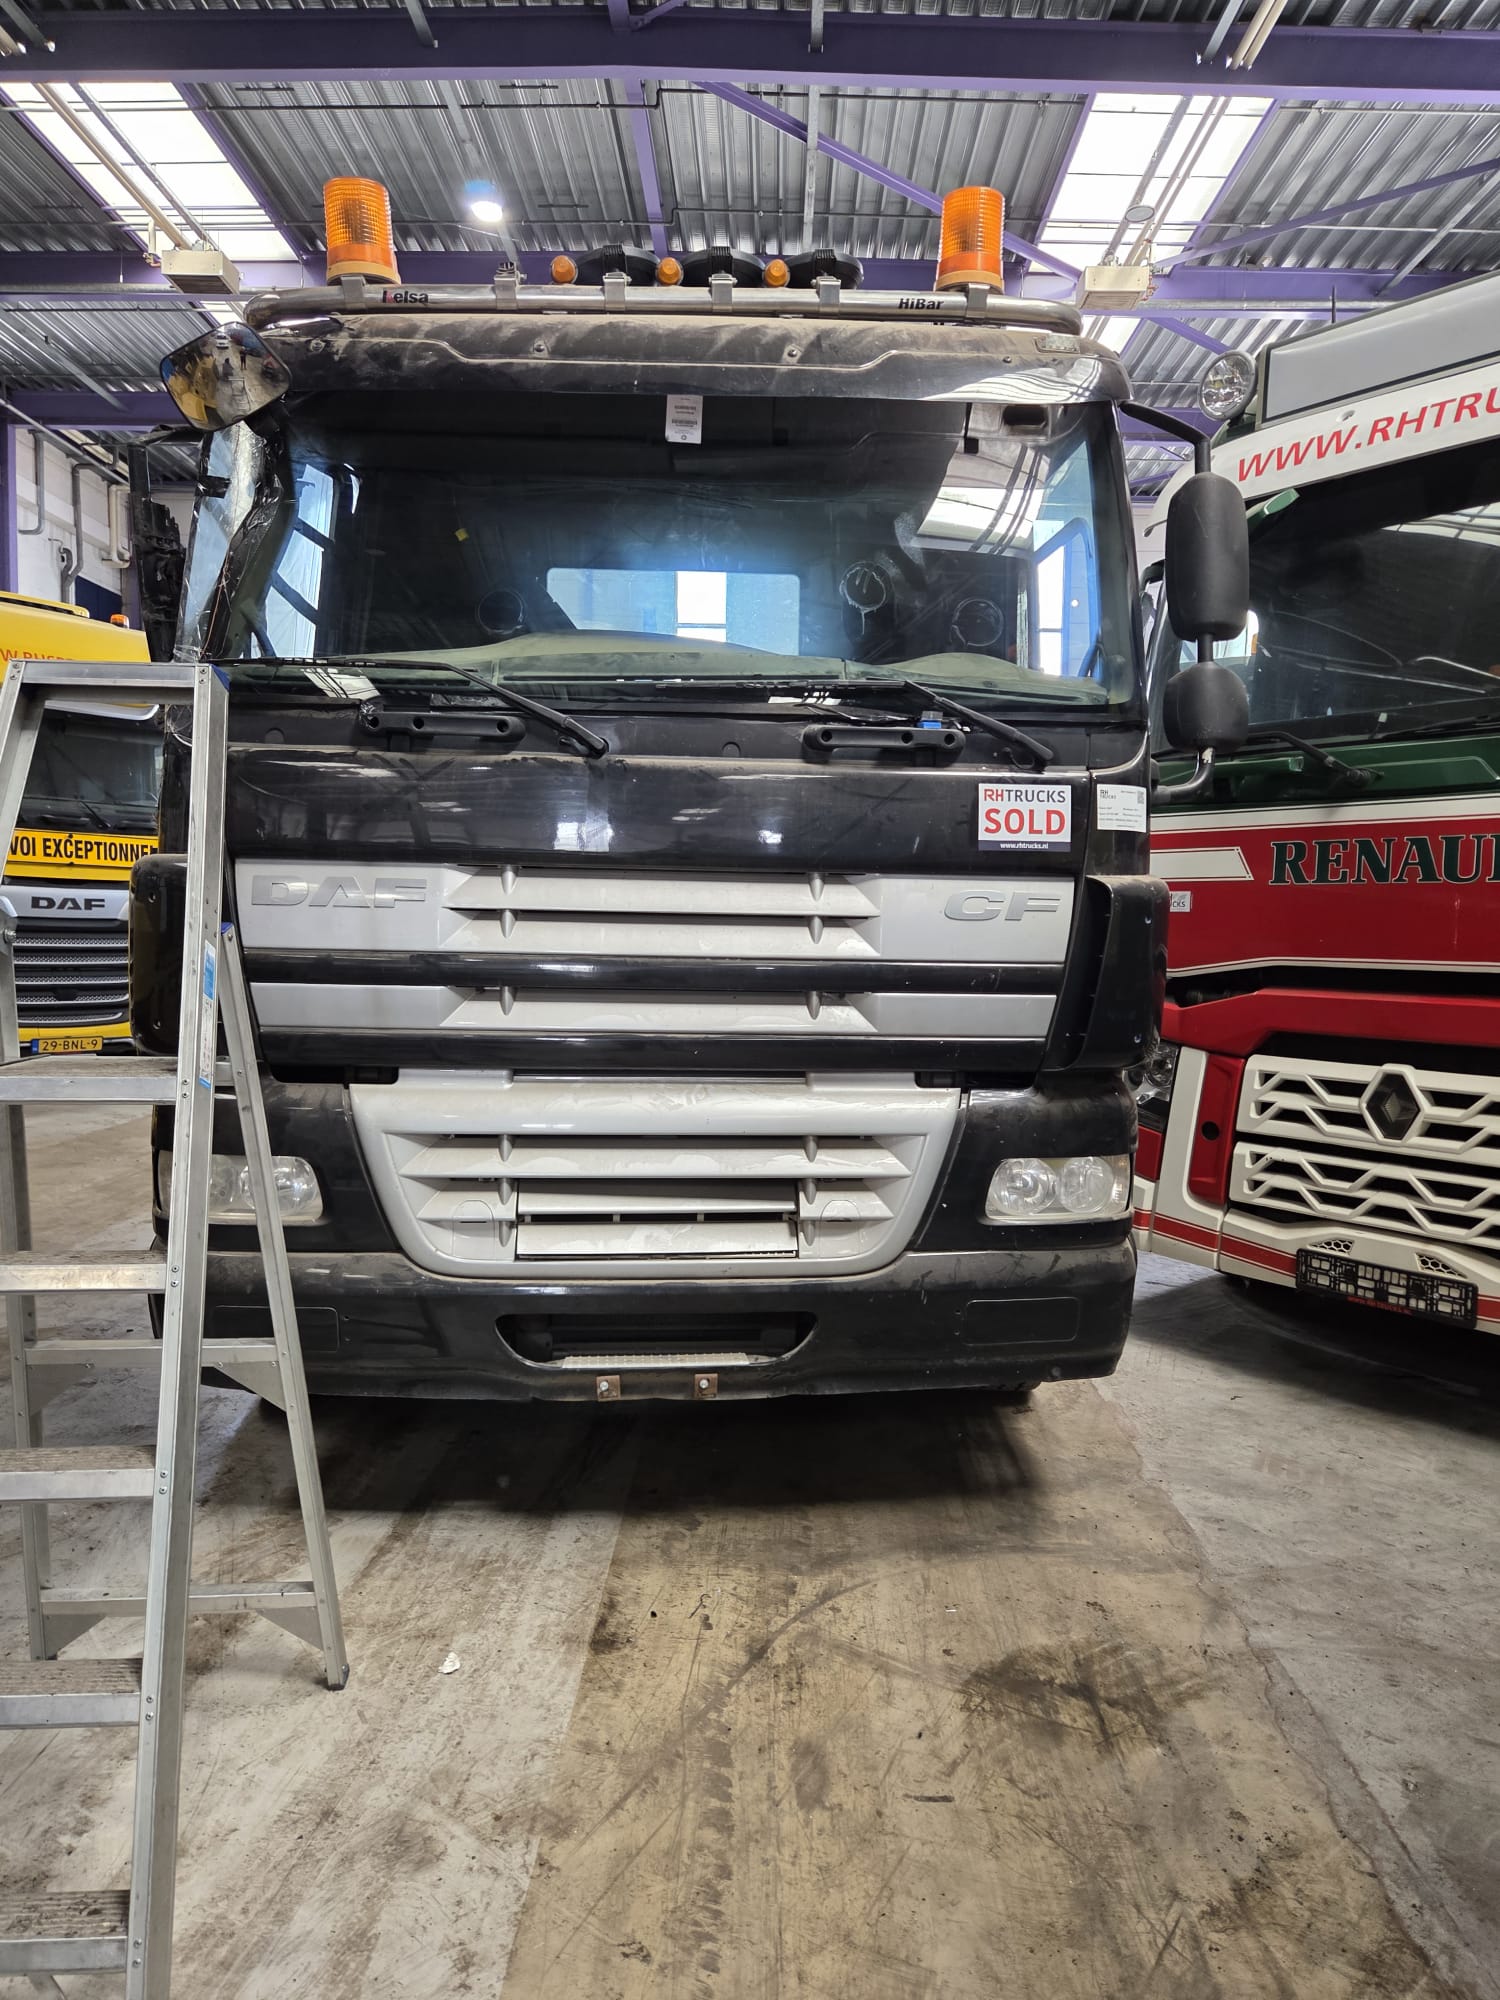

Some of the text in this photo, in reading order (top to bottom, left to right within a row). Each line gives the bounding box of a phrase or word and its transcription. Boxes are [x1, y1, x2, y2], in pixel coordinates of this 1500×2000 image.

[898, 298, 945, 310] HiBar
[984, 808, 1066, 835] SOLD
[251, 875, 427, 909] DAF
[31, 896, 106, 911] DAF
[944, 889, 1061, 922] CF
[42, 1039, 98, 1051] 29-BNL-9
